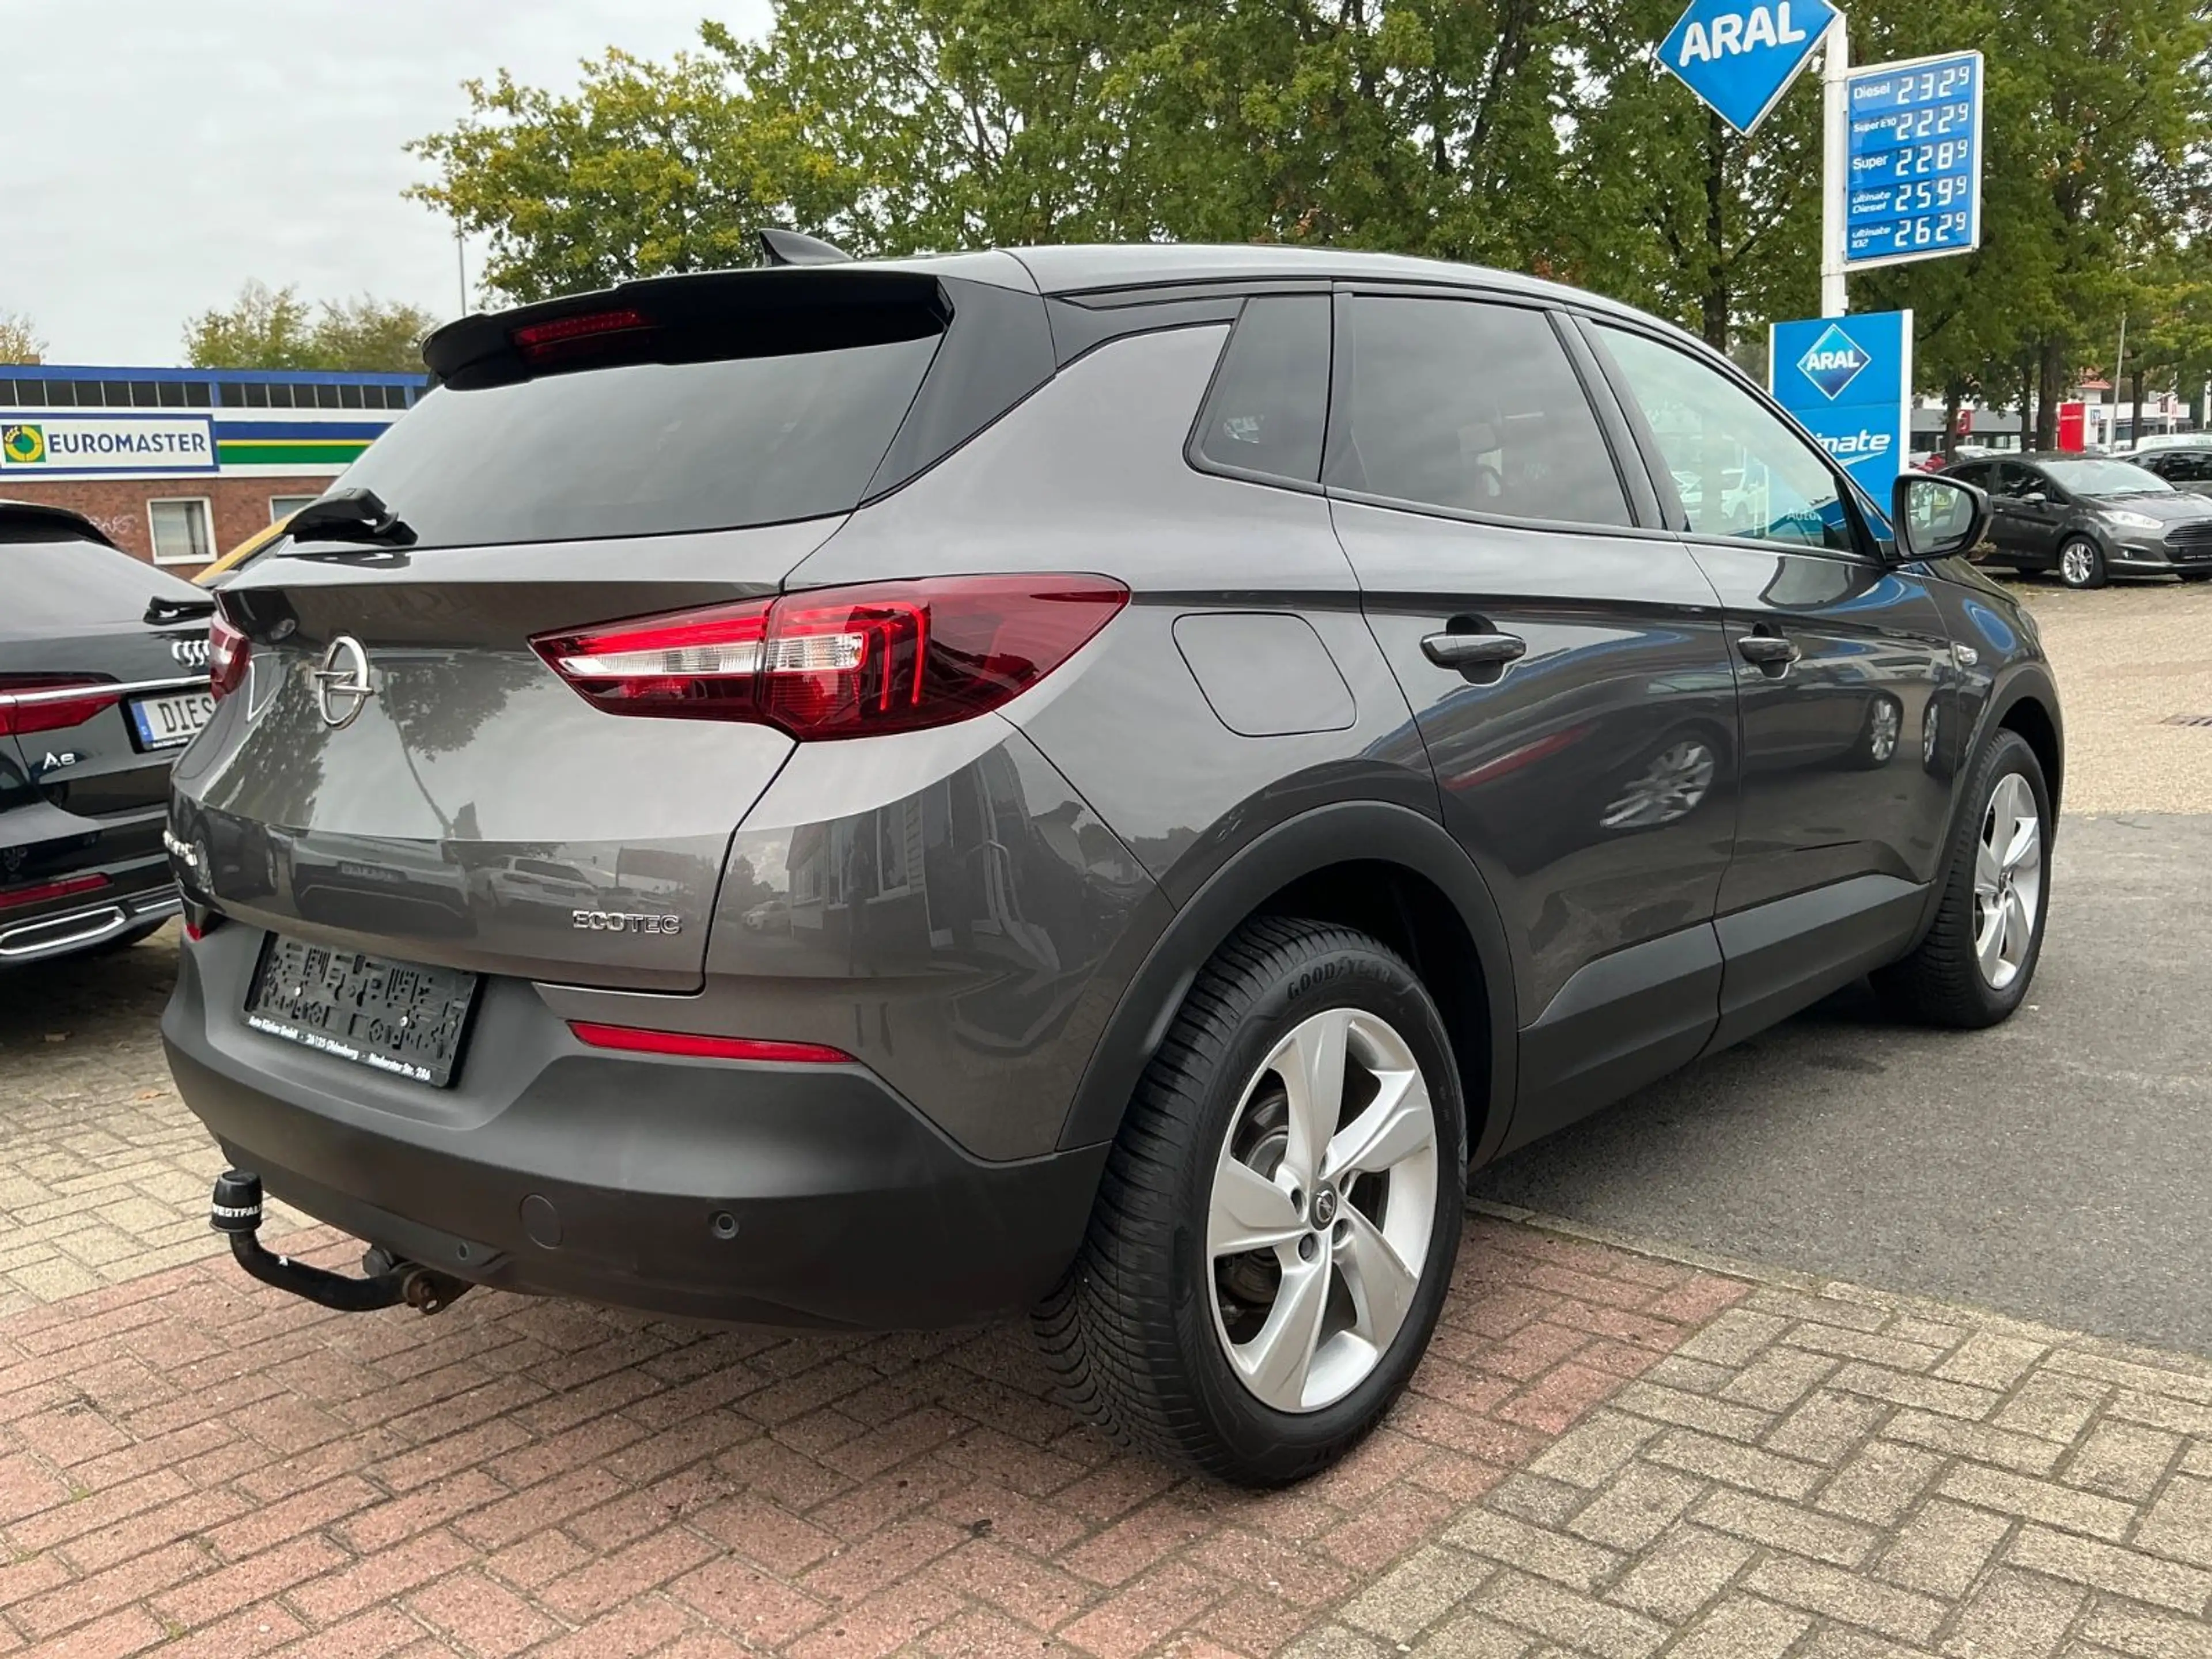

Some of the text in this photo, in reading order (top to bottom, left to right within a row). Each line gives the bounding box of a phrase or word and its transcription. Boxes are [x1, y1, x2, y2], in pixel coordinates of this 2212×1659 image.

[1679, 1, 1806, 67] ARAL
[1854, 81, 1891, 100] Diesel
[1853, 122, 1879, 132] Super
[1880, 118, 1896, 128] E10
[1853, 154, 1888, 171] Super
[1852, 191, 1892, 204] ultimate
[1852, 202, 1887, 214] Diesel
[1852, 226, 1891, 238] ultimate
[1851, 238, 1869, 248] 102
[1806, 349, 1860, 372] ARAL
[48, 433, 206, 453] EUROMASTER
[43, 752, 75, 770] A6
[572, 910, 680, 934] ECOTEC
